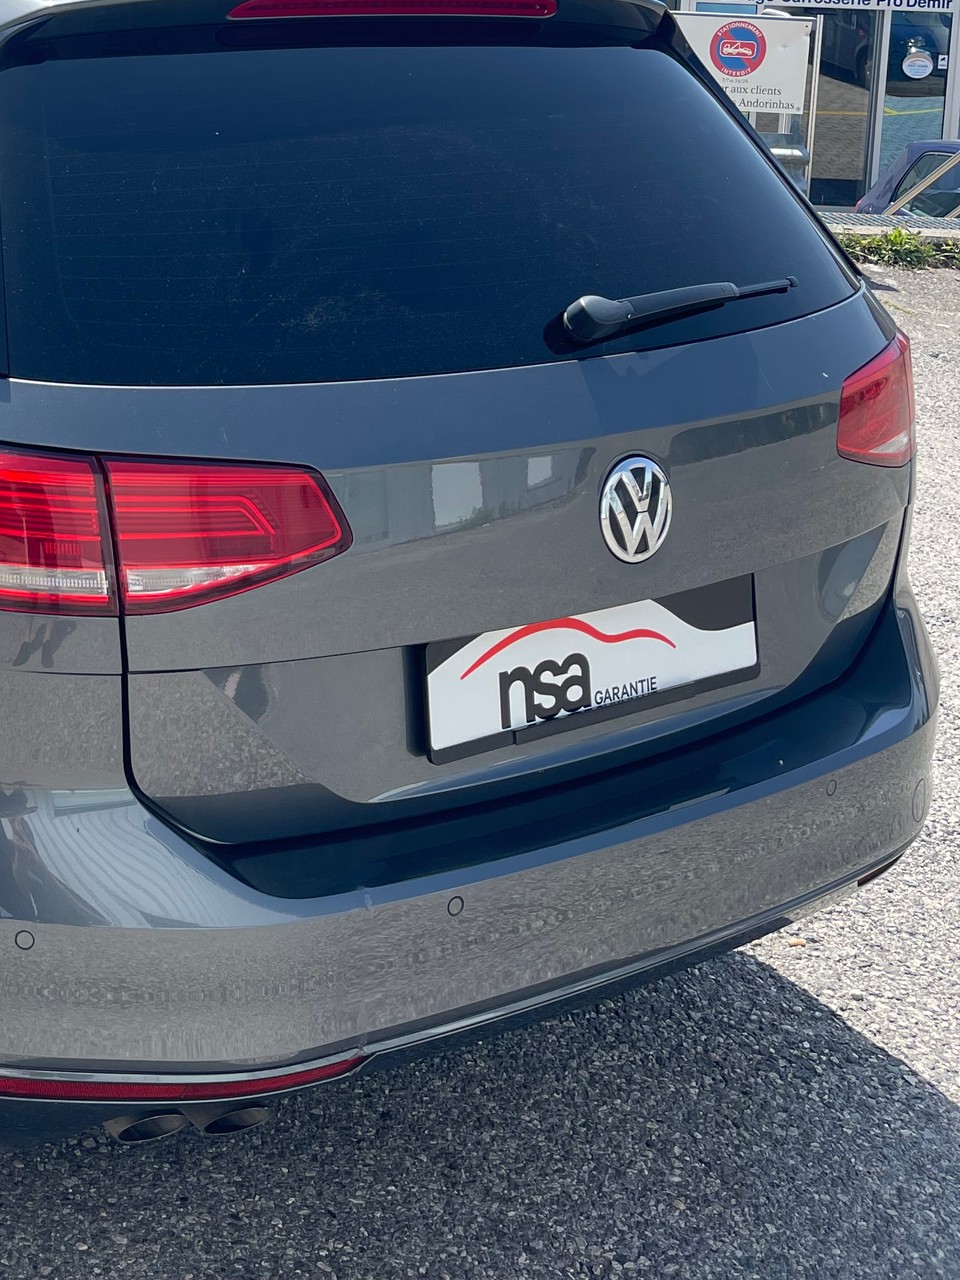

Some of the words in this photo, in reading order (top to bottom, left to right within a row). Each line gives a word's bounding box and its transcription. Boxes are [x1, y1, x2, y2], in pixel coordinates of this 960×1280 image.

[717, 21, 763, 38] STATIONNEMENT
[720, 67, 752, 77] INTERDIT
[730, 86, 748, 94] aux
[750, 85, 782, 95] clients
[738, 98, 795, 109] Andorinhas
[498, 652, 592, 730] nsa
[593, 675, 658, 706] GARANTIE
